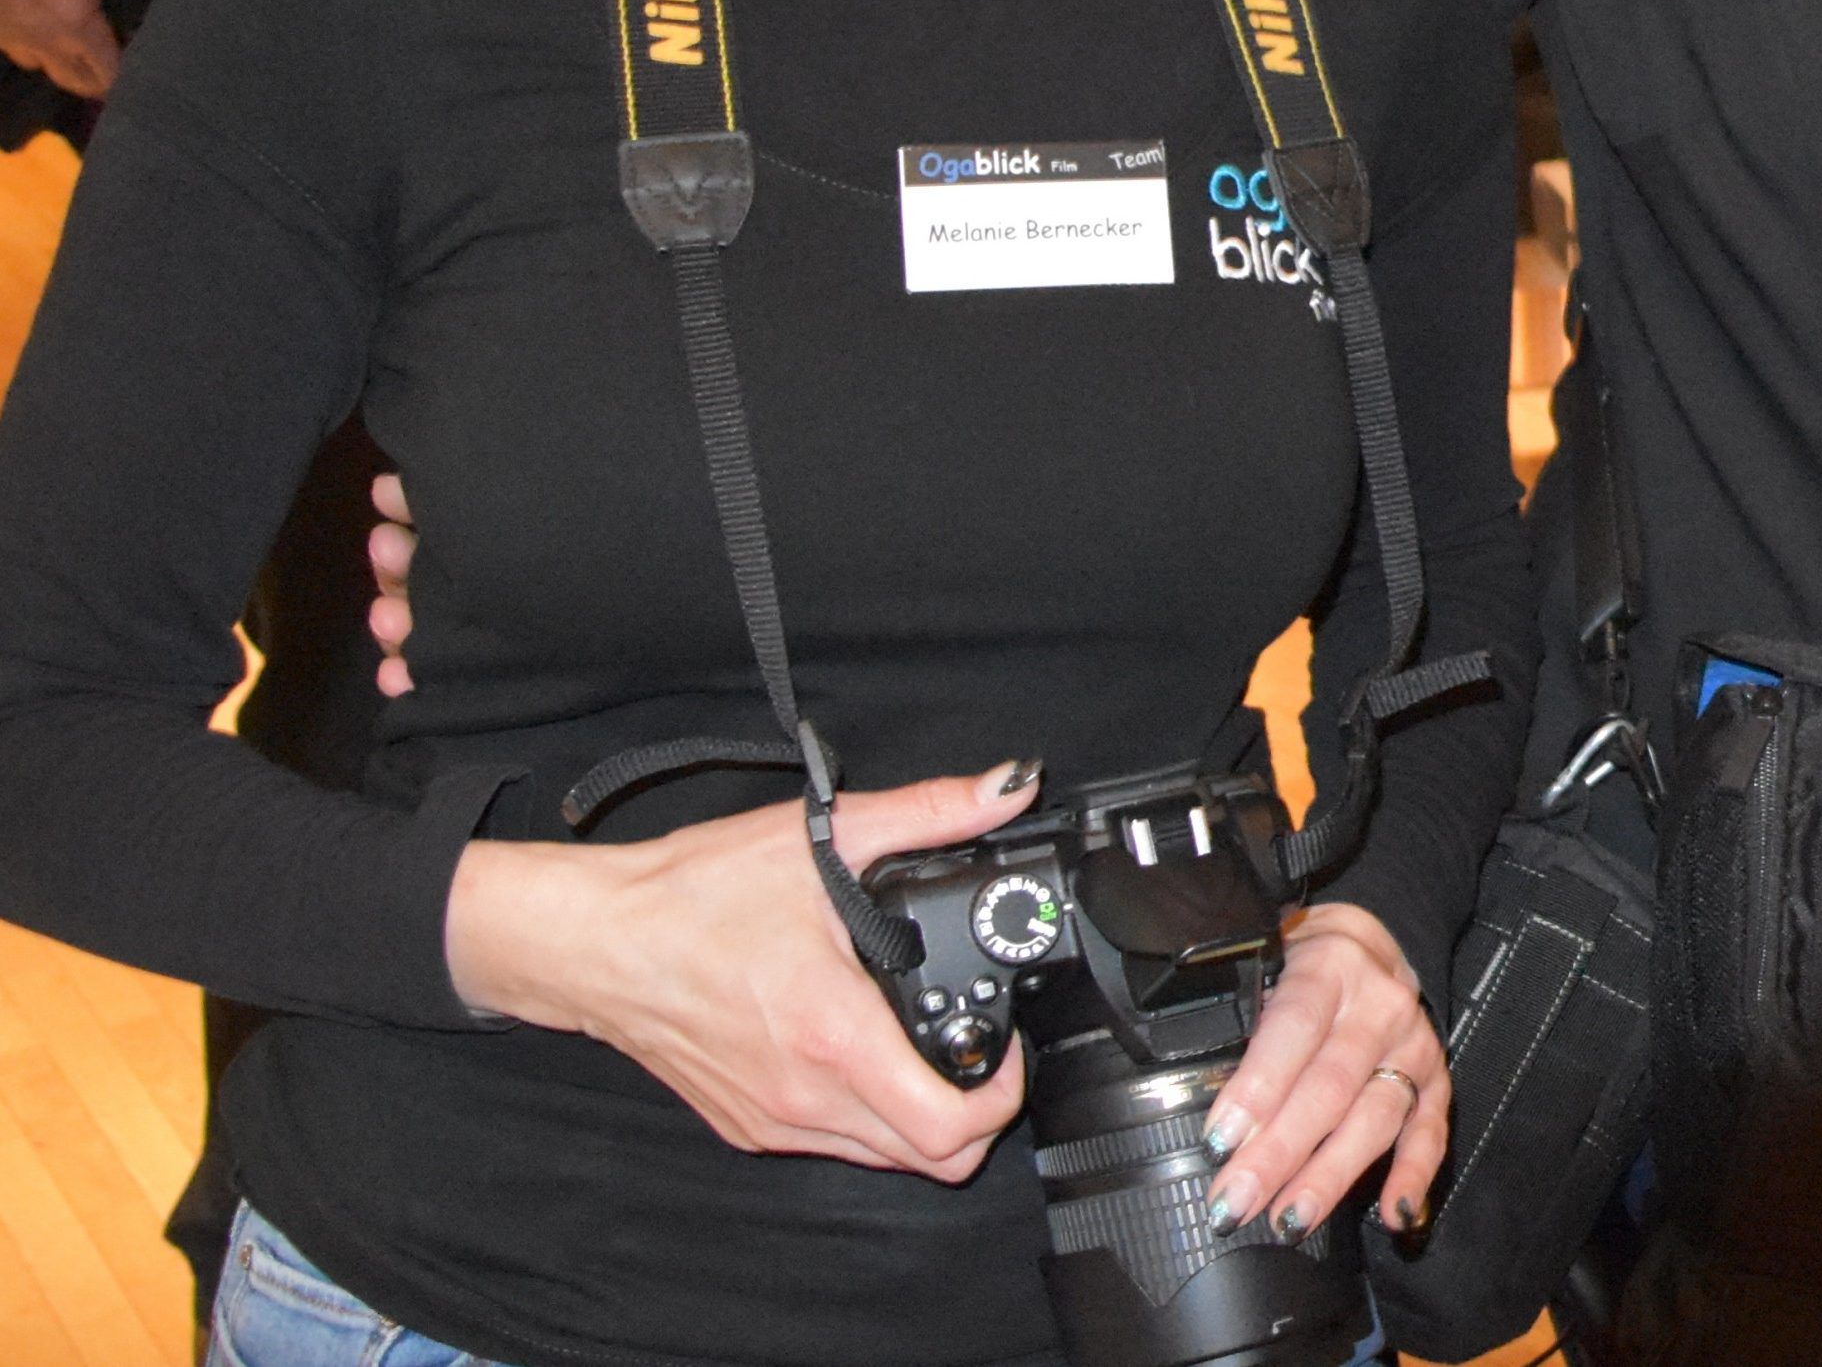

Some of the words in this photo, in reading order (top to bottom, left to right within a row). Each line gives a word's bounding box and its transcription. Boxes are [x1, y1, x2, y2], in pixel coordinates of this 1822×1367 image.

[918, 148, 1042, 184] Ogablick
[1050, 160, 1079, 174] Film
[1108, 146, 1164, 171] Team
[928, 220, 1018, 244] Melanie
[1025, 217, 1143, 240] Bernecker
